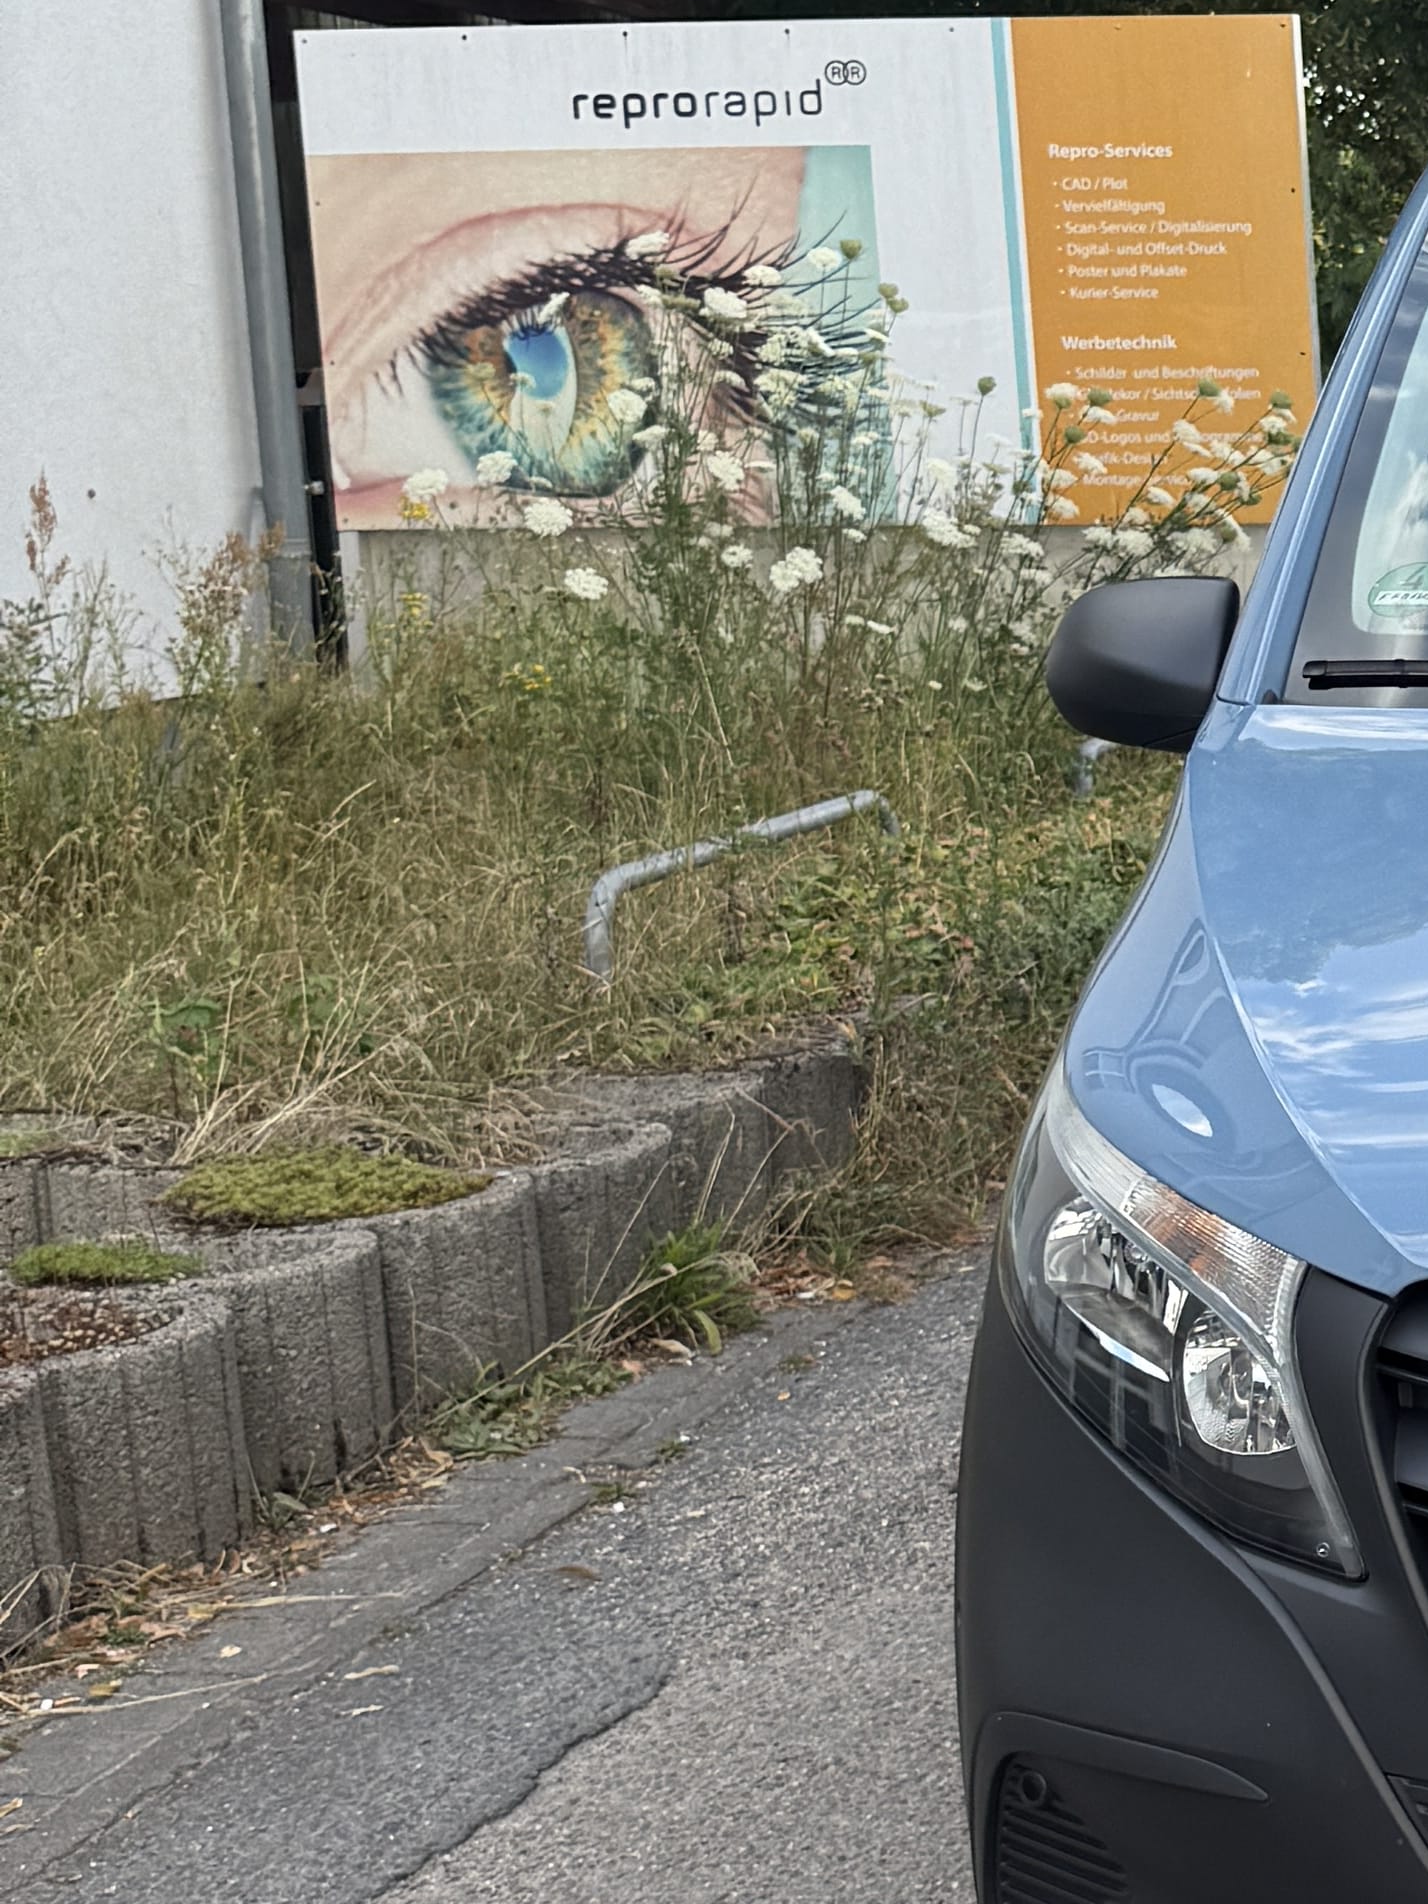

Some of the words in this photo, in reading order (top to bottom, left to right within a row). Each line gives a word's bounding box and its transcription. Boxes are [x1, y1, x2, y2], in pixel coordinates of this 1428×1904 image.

[572, 78, 822, 129] reprorapid
[1048, 142, 1173, 160] Repro-Services
[1061, 178, 1091, 190] CAD
[1102, 177, 1128, 190] Plot
[1062, 199, 1165, 215] Vervielfältigung
[1065, 221, 1147, 234] Scan-Service
[1158, 220, 1252, 236] Digitalisierung
[1117, 243, 1143, 255] und
[1068, 265, 1108, 277] Poster
[1112, 265, 1137, 277] und
[1140, 264, 1187, 277] Plakate
[1070, 286, 1159, 299] Kurier-Service
[1061, 335, 1177, 350] Werbetechnik
[1074, 365, 1127, 379] Schilder
[1134, 365, 1159, 379] und
